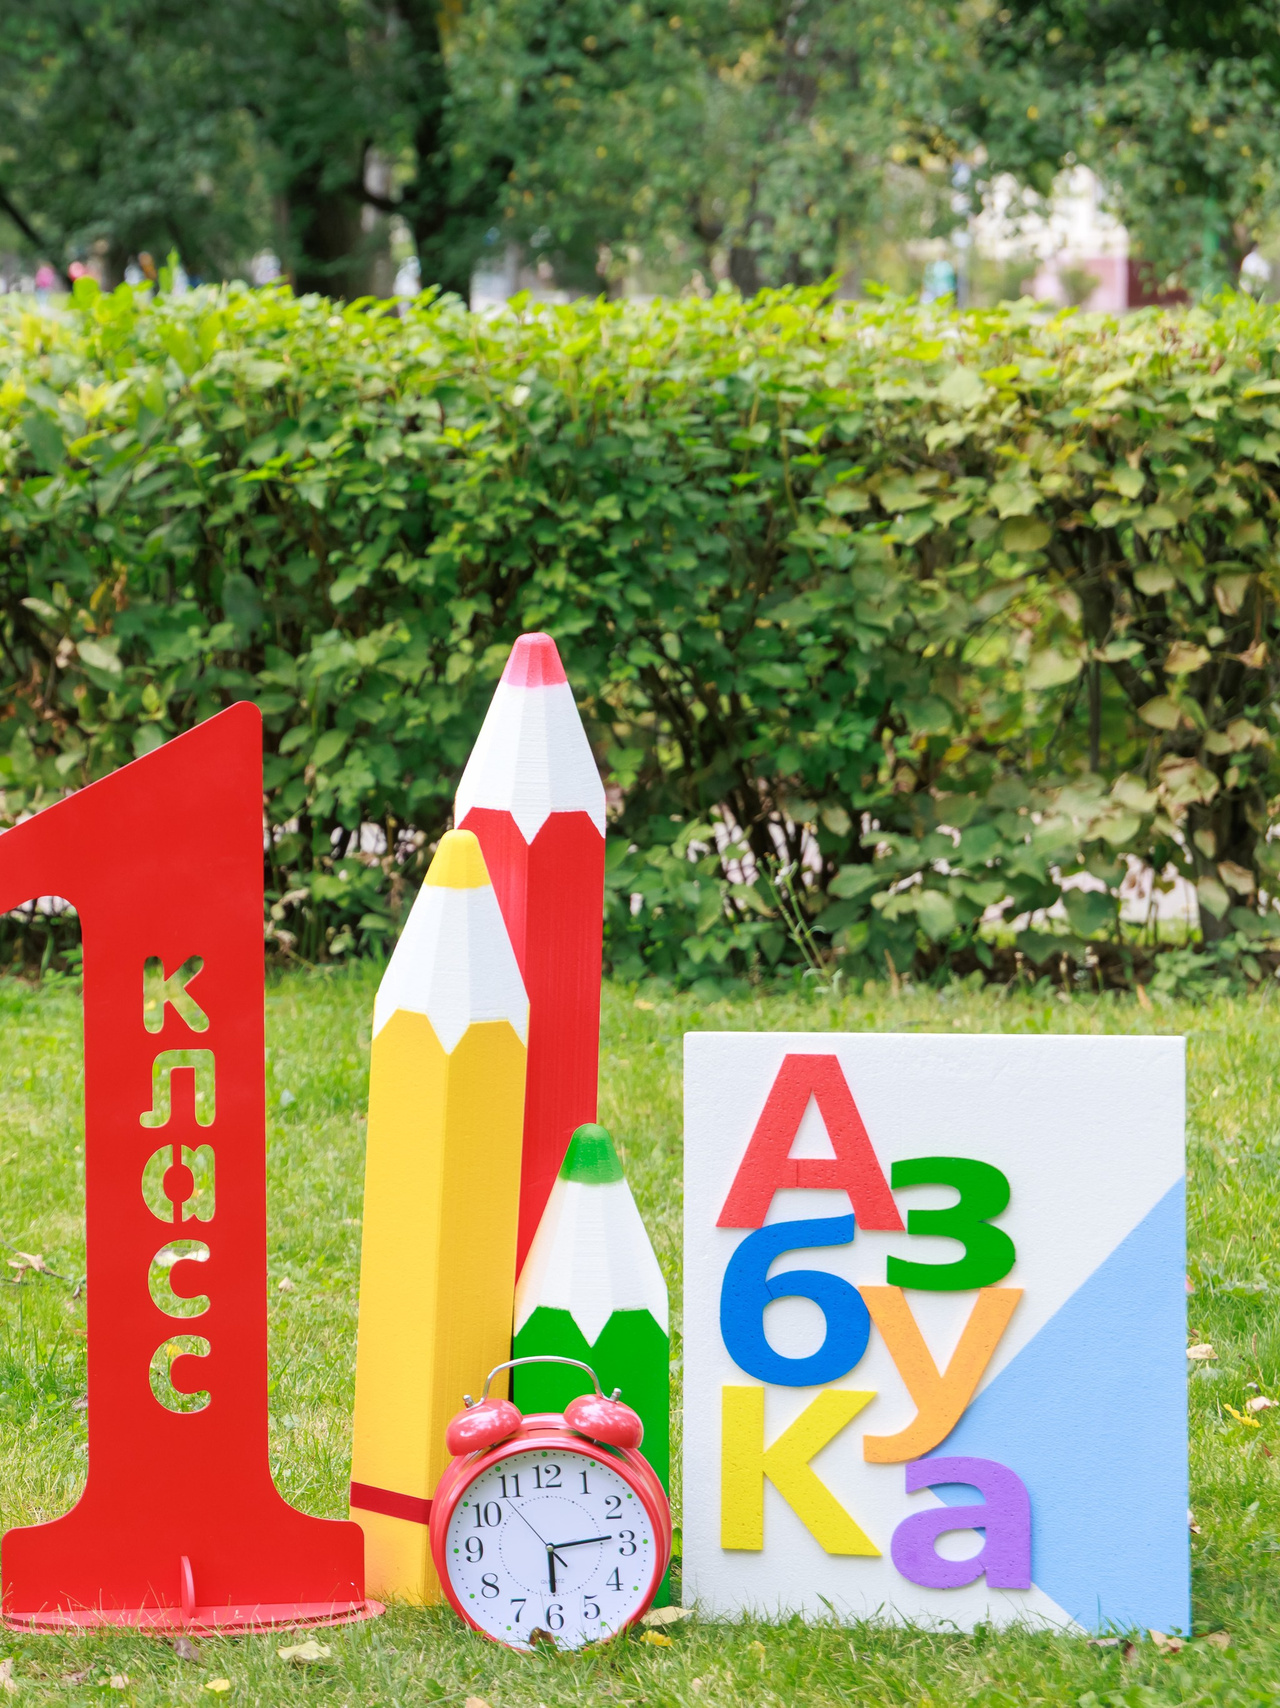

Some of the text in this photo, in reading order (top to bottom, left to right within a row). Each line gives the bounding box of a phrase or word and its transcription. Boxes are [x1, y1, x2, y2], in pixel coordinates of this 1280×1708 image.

[498, 1474, 522, 1498] 11
[531, 1464, 562, 1489] 12
[579, 1470, 592, 1494] 1
[472, 1502, 502, 1528] 10
[604, 1495, 623, 1519] 2
[464, 1536, 484, 1563] 9
[618, 1530, 637, 1556] 3
[481, 1573, 500, 1598] 8
[605, 1567, 624, 1591] 4
[510, 1599, 527, 1623] 7
[546, 1604, 564, 1630] 6
[583, 1595, 601, 1619] 5
